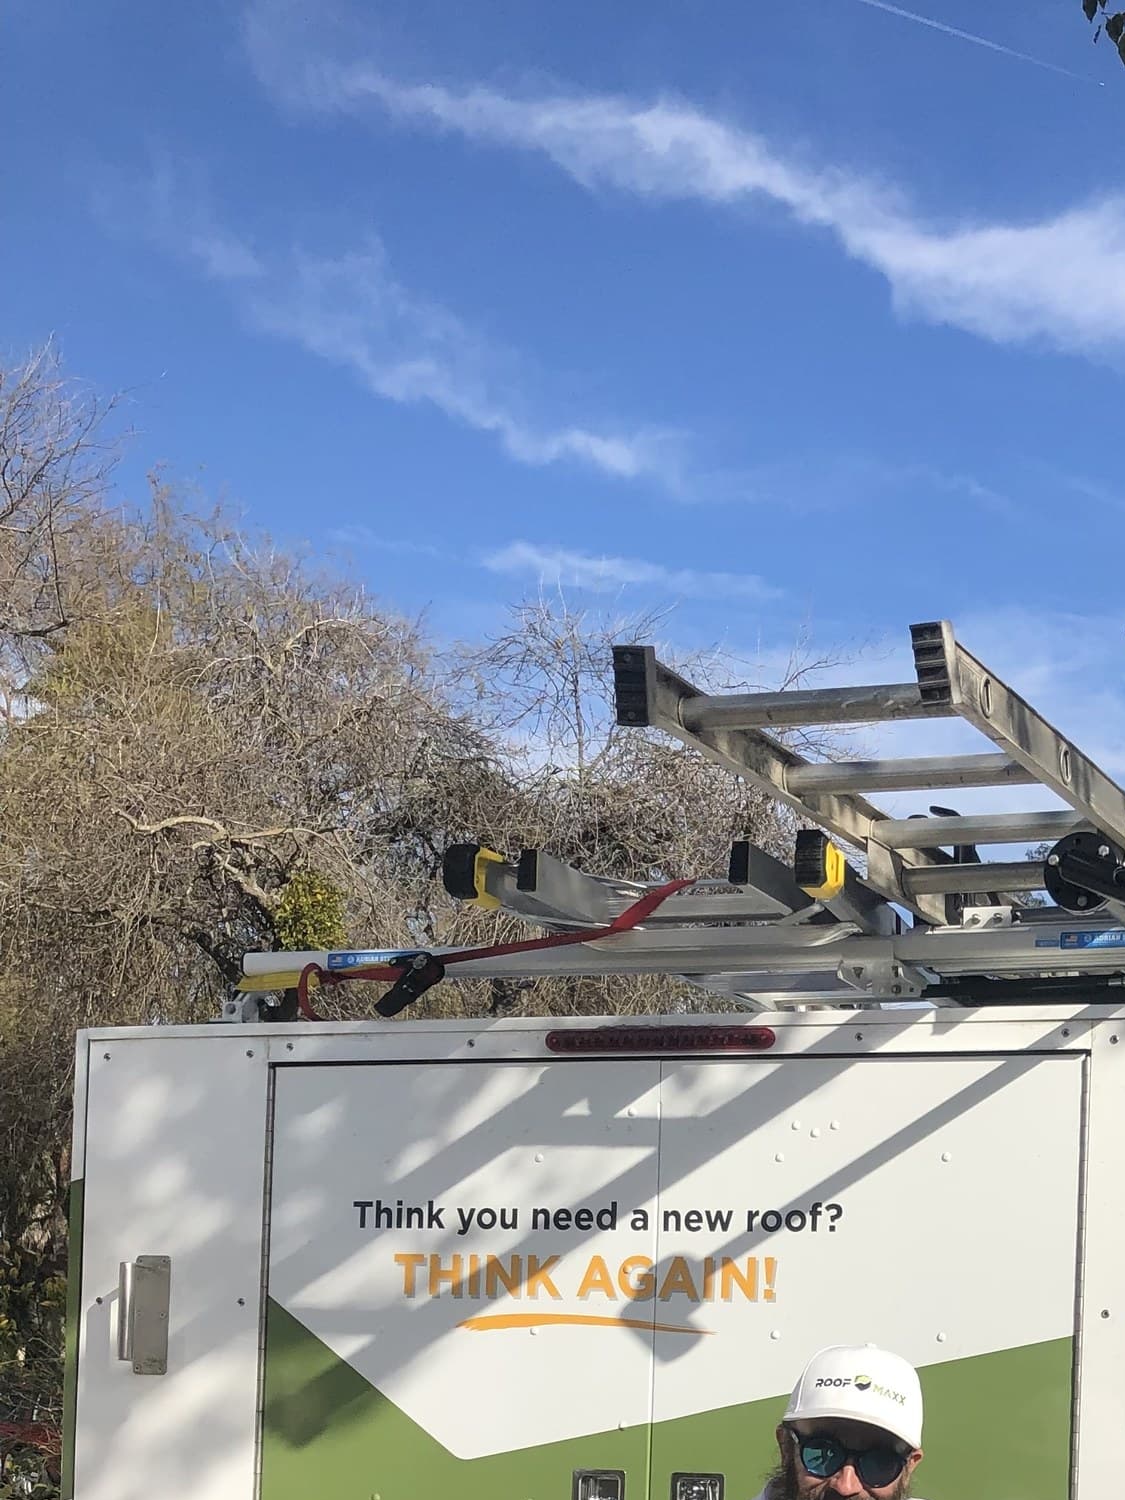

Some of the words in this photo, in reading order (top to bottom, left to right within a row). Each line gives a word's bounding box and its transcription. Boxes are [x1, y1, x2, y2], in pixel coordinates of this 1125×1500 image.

[353, 1200, 445, 1231] Think
[456, 1207, 519, 1236] you
[531, 1202, 618, 1232] need
[630, 1208, 650, 1232] a
[663, 1208, 734, 1232] new
[746, 1200, 843, 1234] roof?
[394, 1252, 563, 1300] THINK
[576, 1254, 779, 1302] AGAIN!
[815, 1378, 852, 1389] ROOF
[874, 1384, 906, 1406] MAXX
